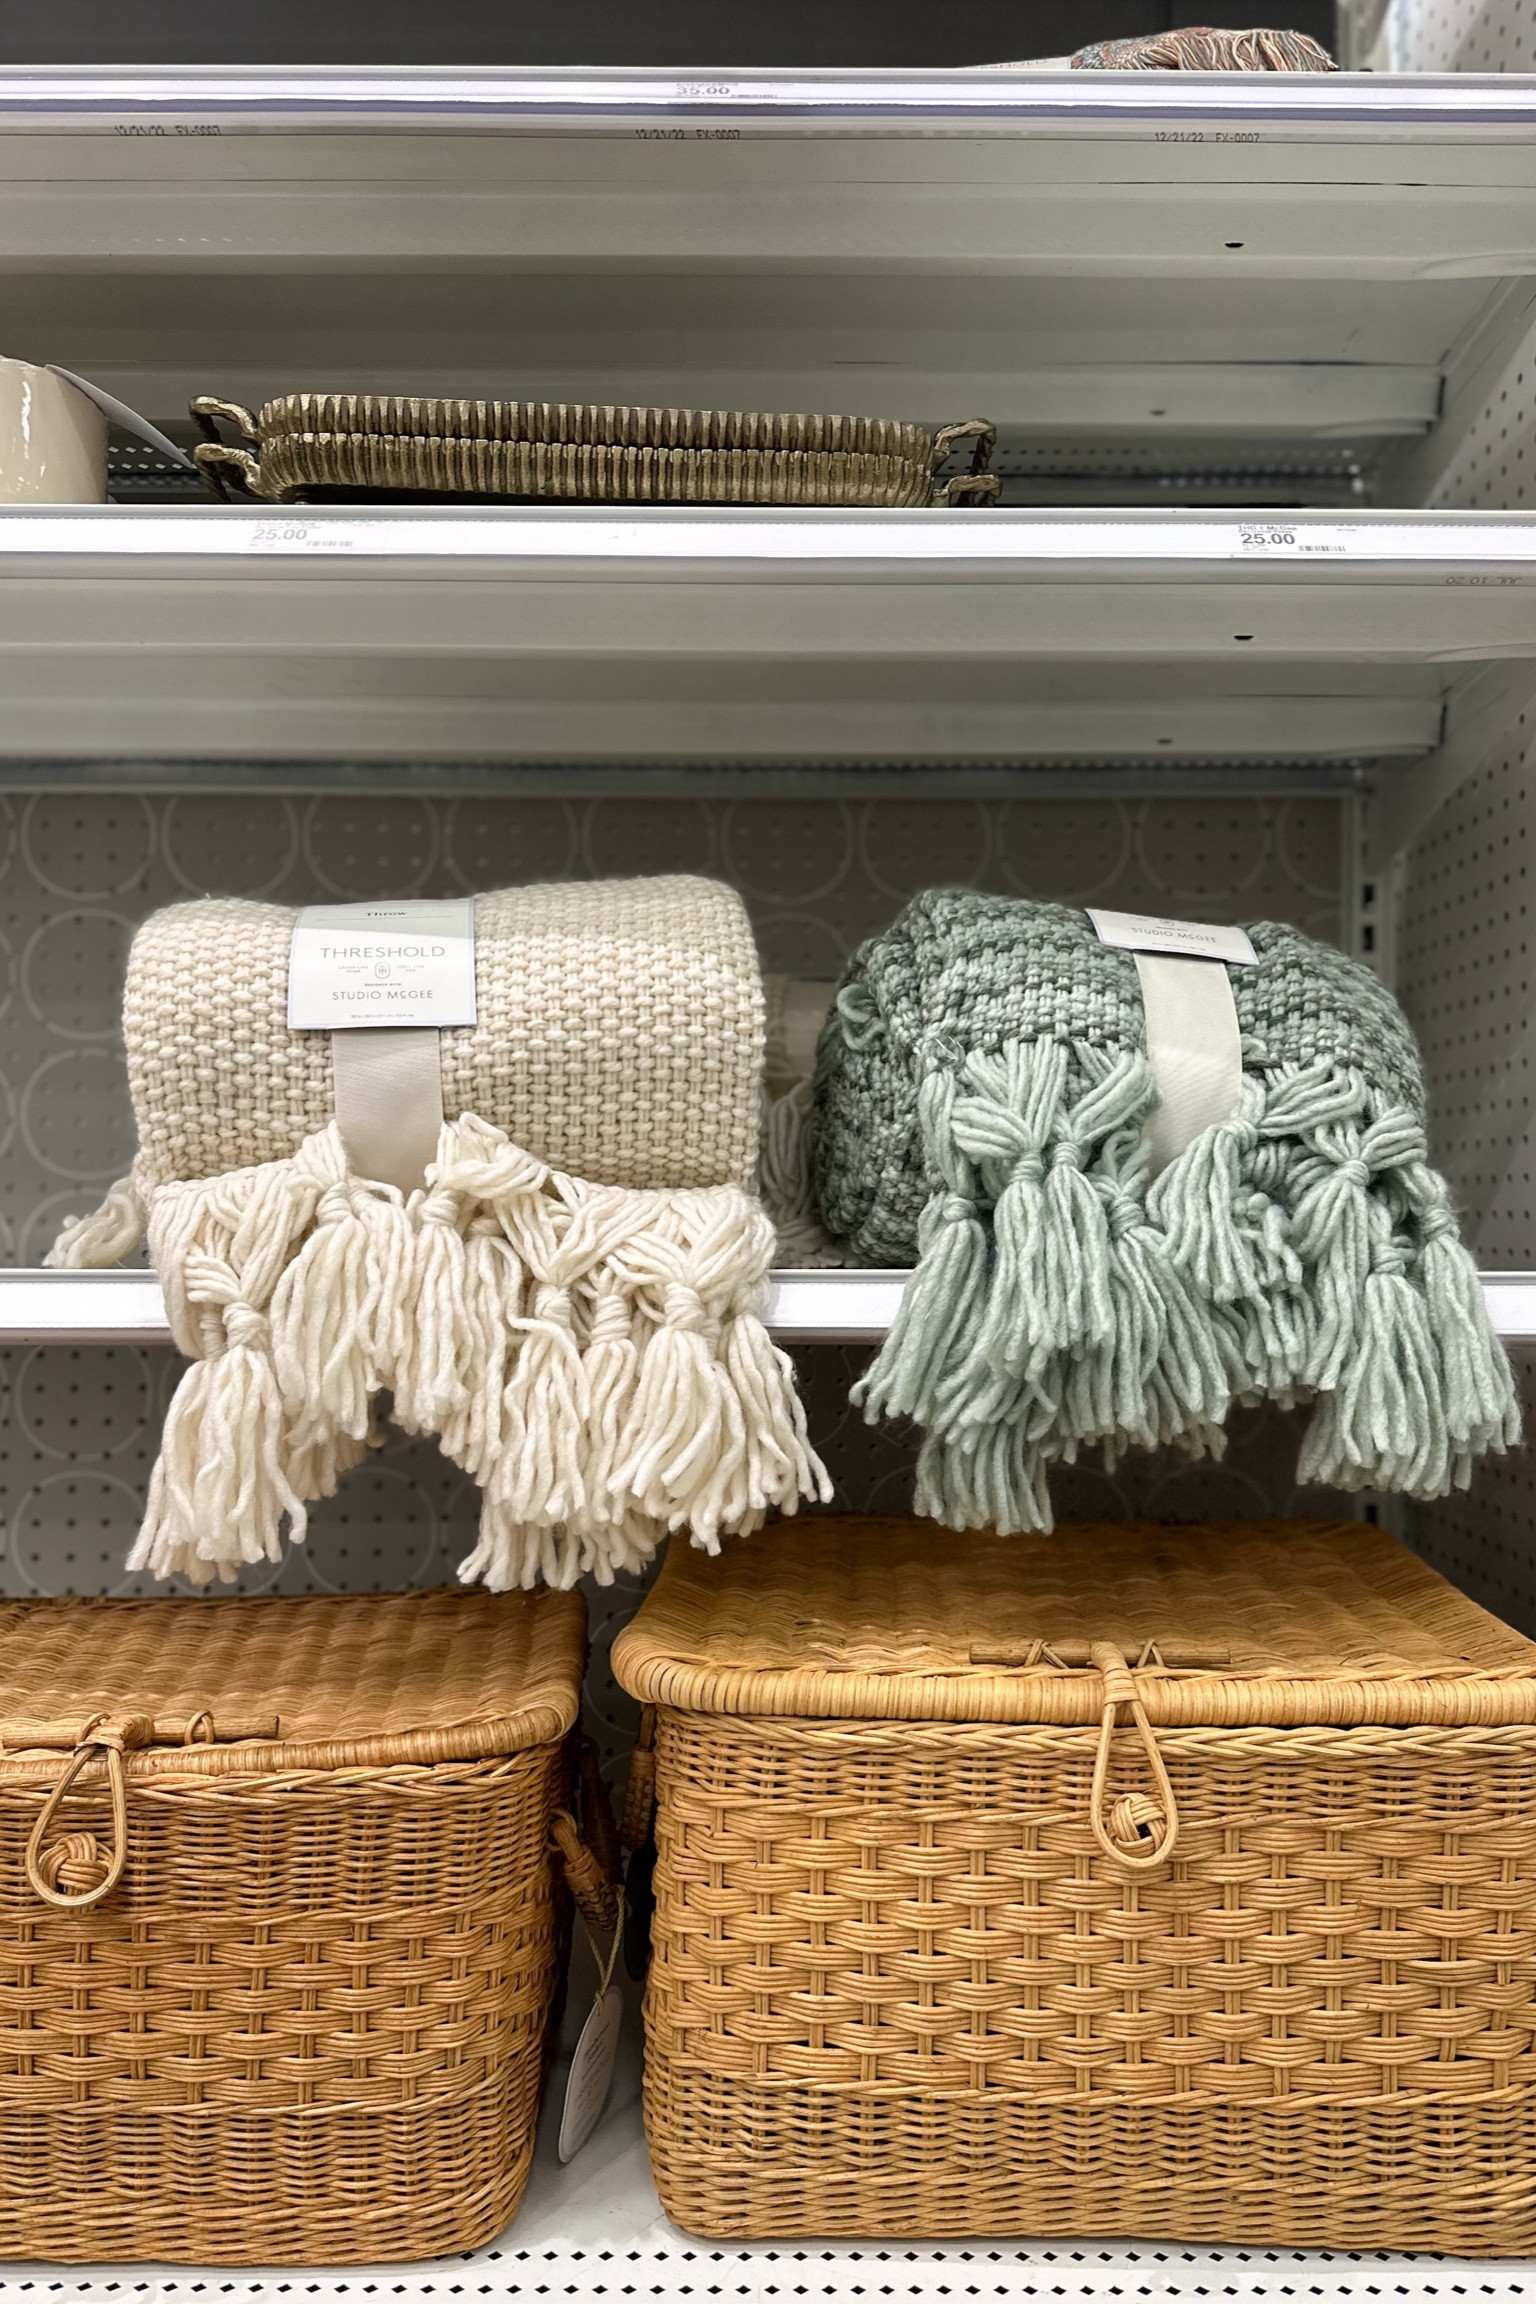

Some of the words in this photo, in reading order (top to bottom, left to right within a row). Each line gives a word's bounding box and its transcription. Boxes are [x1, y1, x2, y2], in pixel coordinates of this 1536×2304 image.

[676, 86, 730, 95] 35.00
[1155, 132, 1204, 143] 12/21/22
[1215, 132, 1260, 143] FX-0007
[253, 529, 308, 540] 25.00
[1240, 533, 1296, 545] 25.00
[1131, 927, 1174, 937] STUDIO
[320, 946, 446, 959] THRESHOLD
[332, 991, 381, 1001] STUDIO
